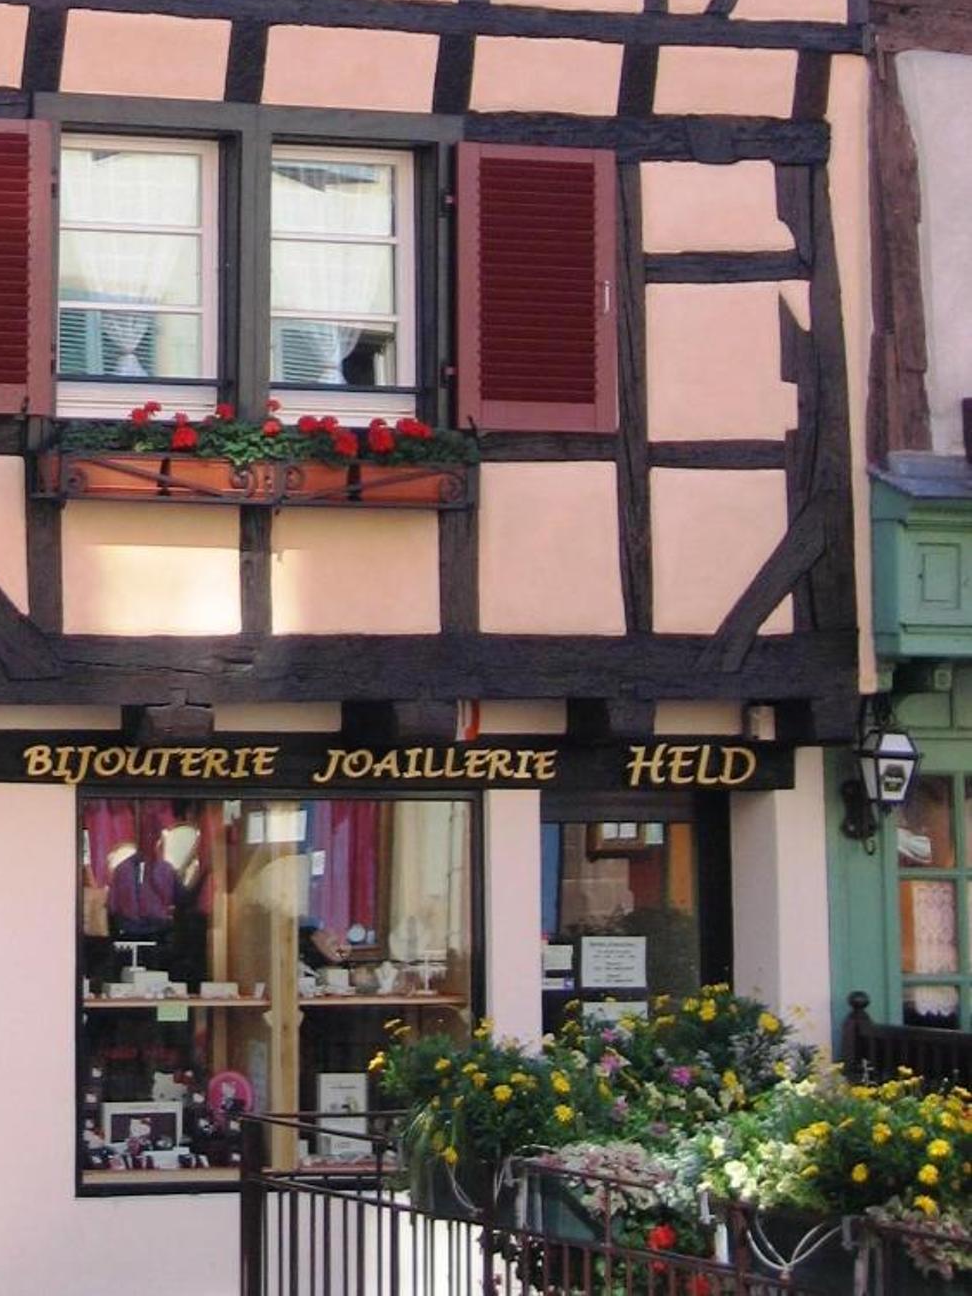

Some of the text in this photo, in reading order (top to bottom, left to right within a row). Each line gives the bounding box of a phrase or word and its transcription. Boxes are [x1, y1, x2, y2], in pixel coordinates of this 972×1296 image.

[23, 743, 757, 786] BIJOUTERIE JOAILLERIE HELD
